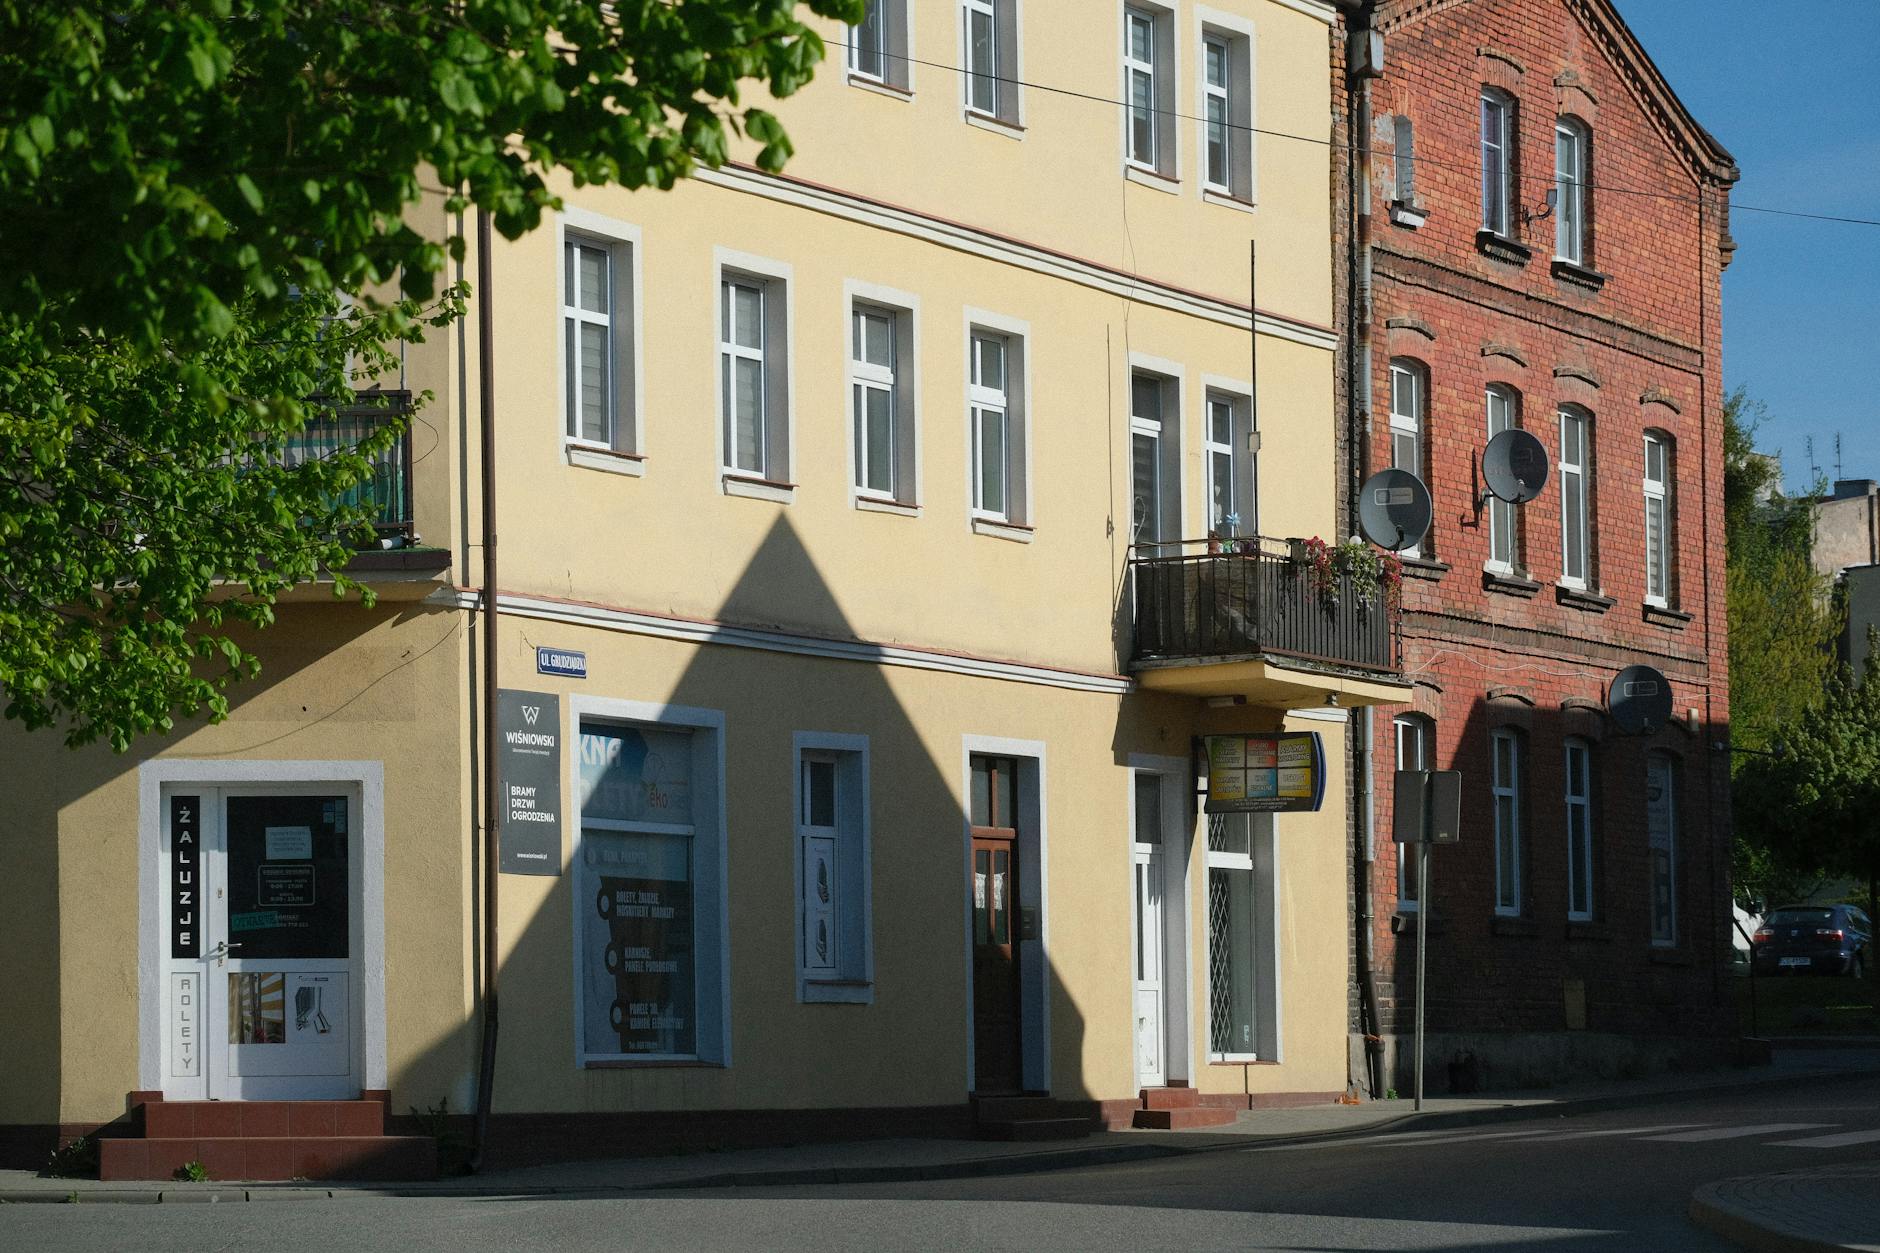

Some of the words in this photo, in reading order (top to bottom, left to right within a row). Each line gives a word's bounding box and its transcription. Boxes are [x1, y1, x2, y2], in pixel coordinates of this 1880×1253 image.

[506, 729, 554, 747] WIŚNIOWSKI
[511, 785, 536, 798] BRAMY
[511, 798, 535, 810] DRZWI
[511, 810, 555, 823] OGRODZENIA
[179, 805, 192, 946] ŻALUZJE
[180, 979, 193, 1069] ROLETY
